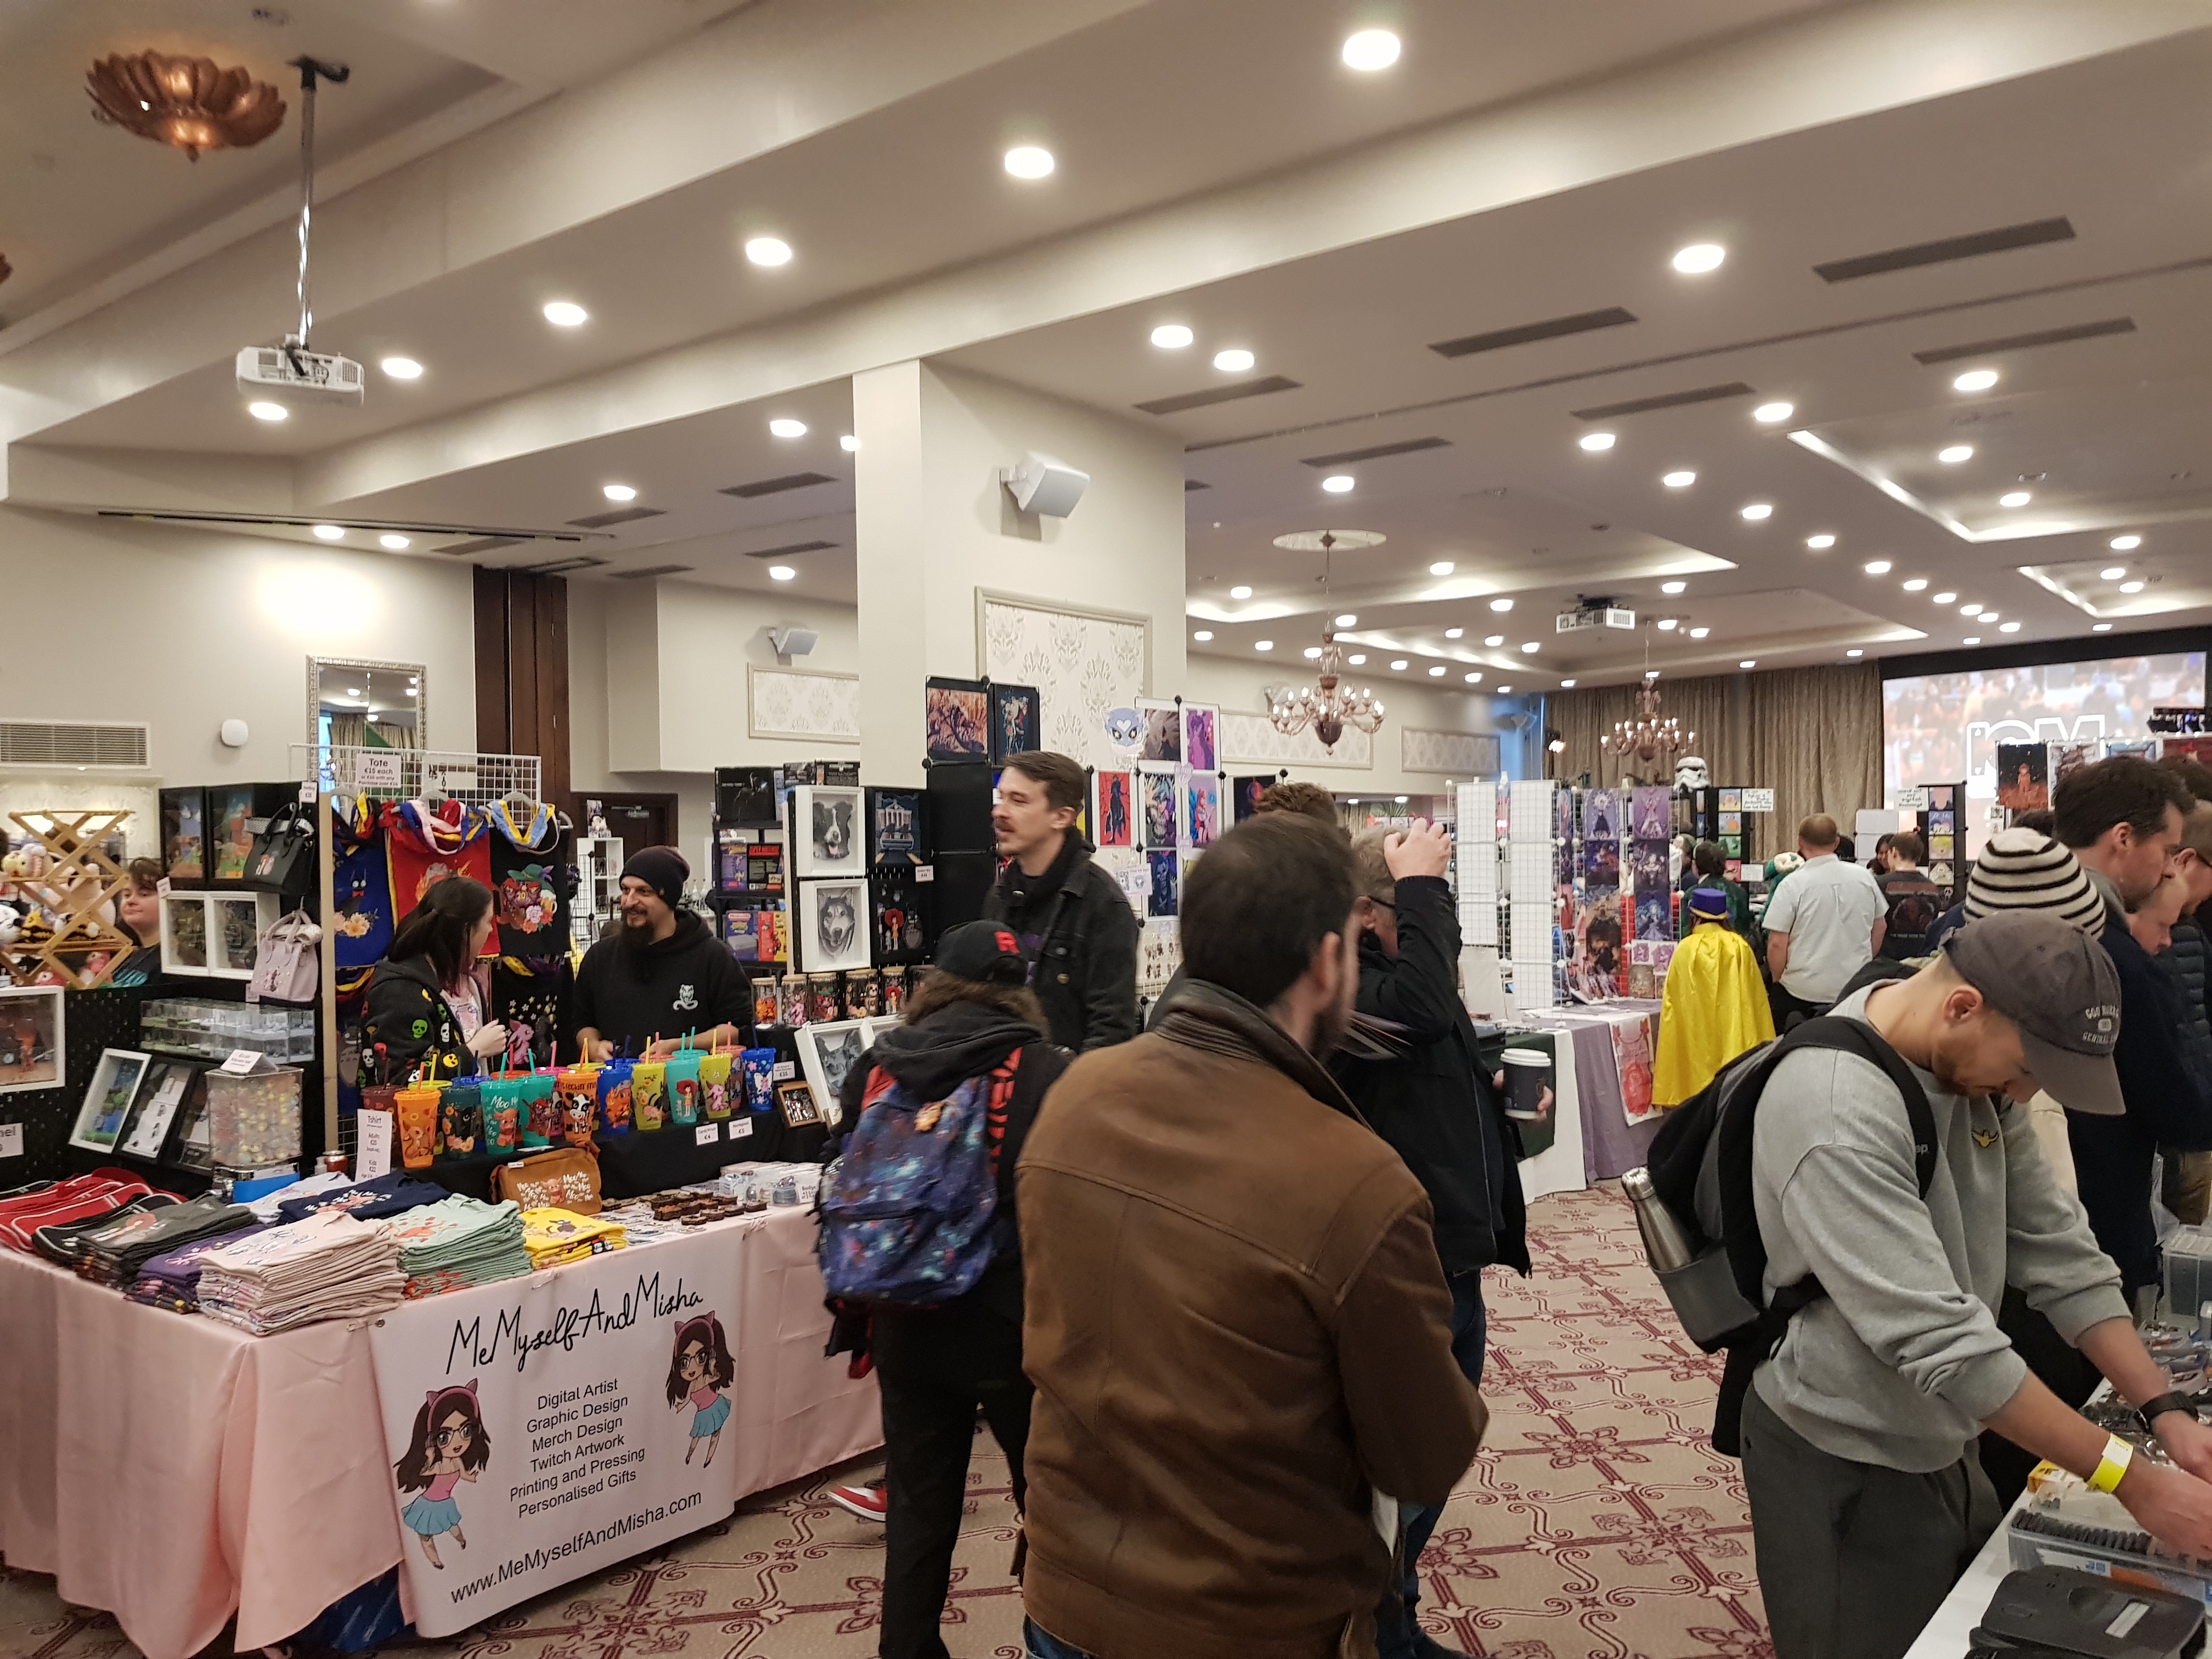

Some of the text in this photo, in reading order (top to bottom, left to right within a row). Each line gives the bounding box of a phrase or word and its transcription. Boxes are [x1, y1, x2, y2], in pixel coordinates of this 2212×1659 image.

[369, 758, 388, 767] Tote
[994, 930, 1020, 953] R
[368, 1115, 381, 1124] Tshirt
[490, 1095, 510, 1108] Moo
[446, 1271, 703, 1374] MeMyselfAndMisha
[538, 1378, 618, 1410] Digital Artist
[527, 1396, 628, 1433] Graphic Design
[529, 1434, 625, 1473] Twitch Artwork
[532, 1418, 622, 1453] Merch Design
[510, 1448, 645, 1502] Printing and Pressing
[519, 1470, 636, 1519] Personalised Gifts
[450, 1492, 701, 1604] www.MeMyselfAndMisha.com
